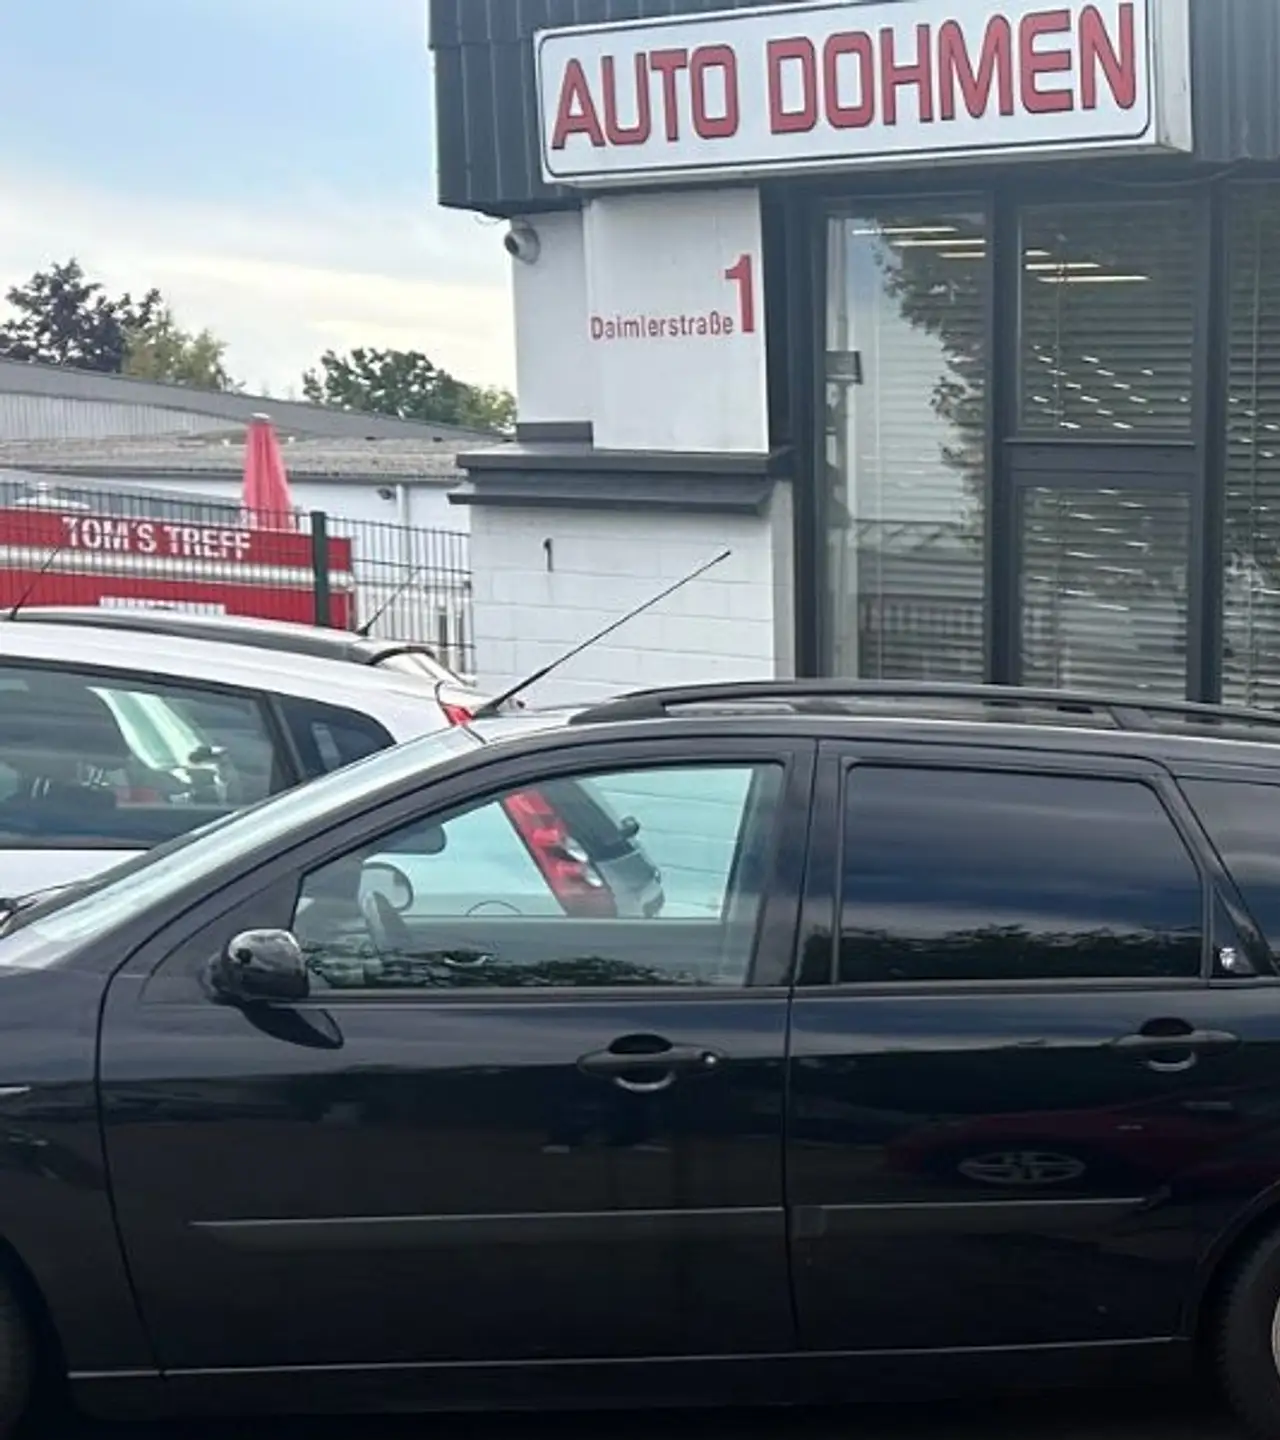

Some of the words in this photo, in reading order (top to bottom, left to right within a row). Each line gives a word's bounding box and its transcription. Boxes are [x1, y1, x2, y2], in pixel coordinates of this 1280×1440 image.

[551, 44, 740, 150] AUTO
[766, 2, 1138, 135] DOHMEN
[590, 309, 735, 340] Daimlerstraße
[724, 253, 756, 333] 1
[62, 515, 158, 553] TOM'S
[163, 525, 251, 560] TREFF
